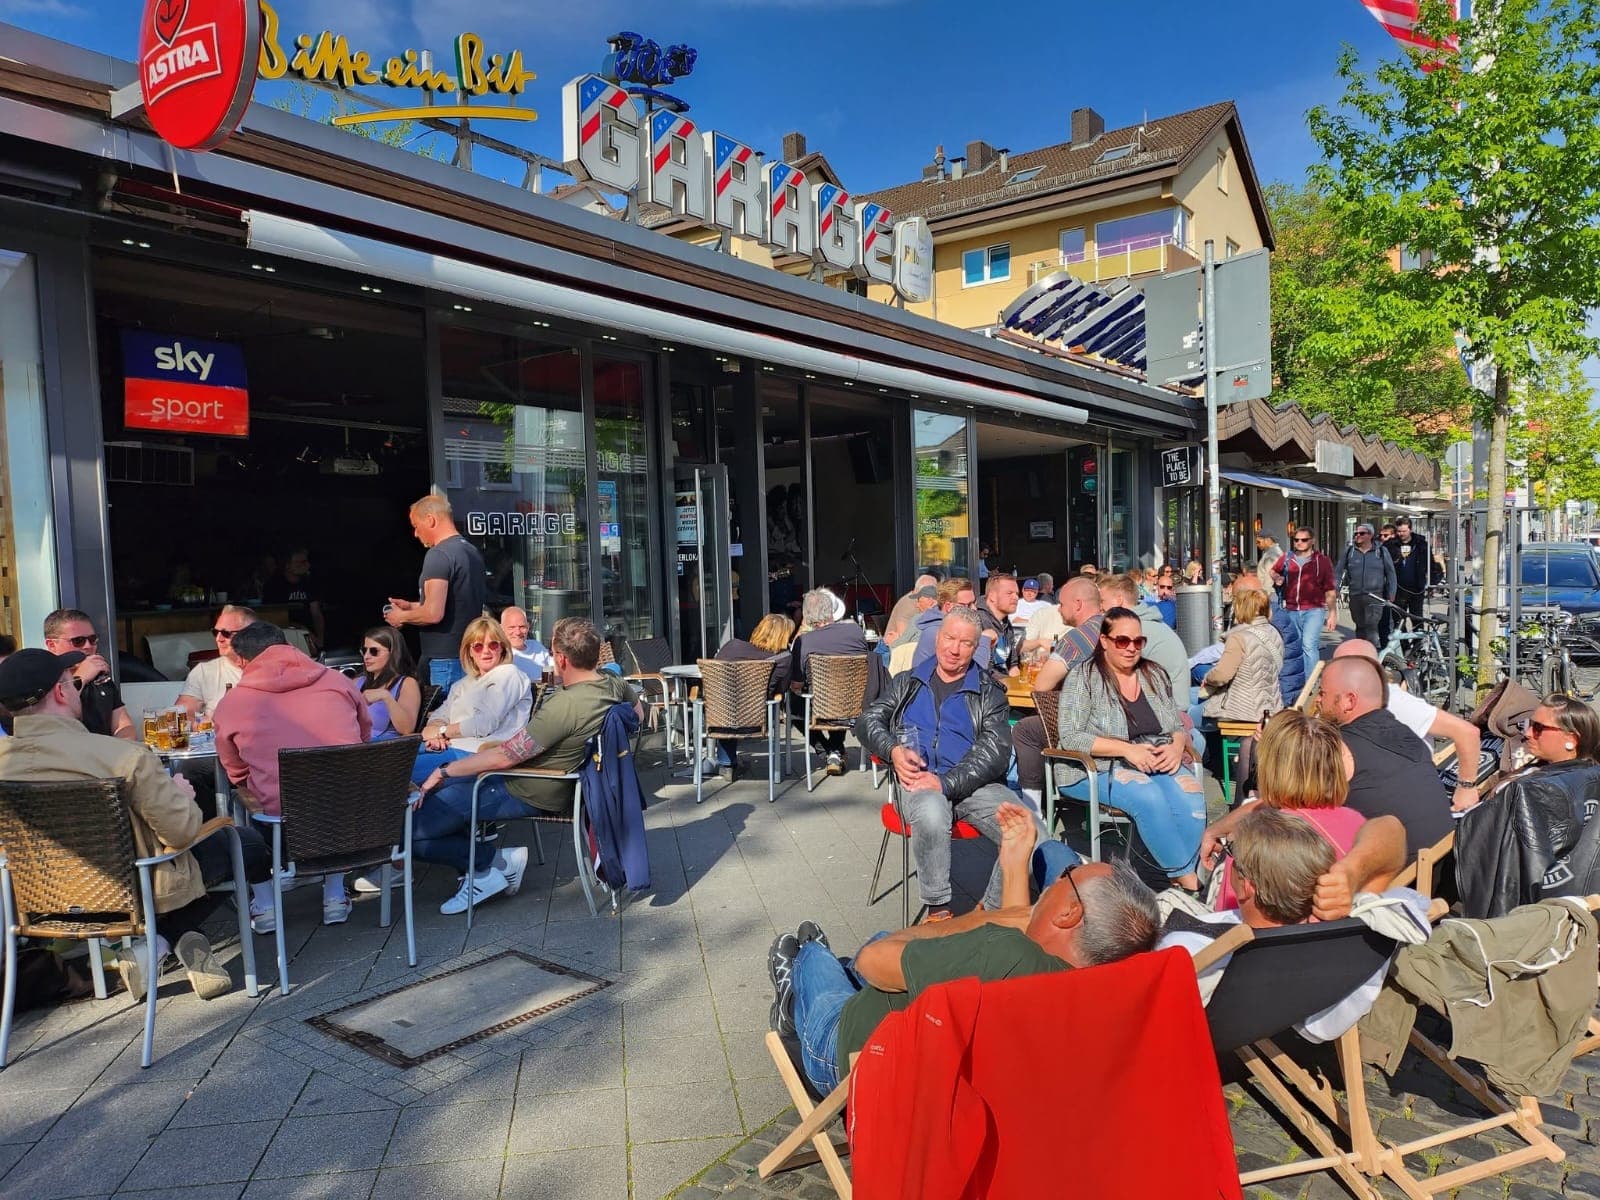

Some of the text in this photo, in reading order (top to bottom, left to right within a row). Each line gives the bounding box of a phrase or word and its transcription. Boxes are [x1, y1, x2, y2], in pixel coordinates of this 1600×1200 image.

[258, 1, 537, 95] Bitte ein Bit
[148, 39, 210, 89] ASTRA
[566, 73, 893, 283] GARAGE
[154, 342, 215, 381] sky
[151, 397, 224, 421] sport
[1166, 460, 1187, 473] PLACE
[1167, 452, 1180, 462] THE
[1170, 470, 1188, 481] TO BE
[467, 512, 576, 535] GARAGE
